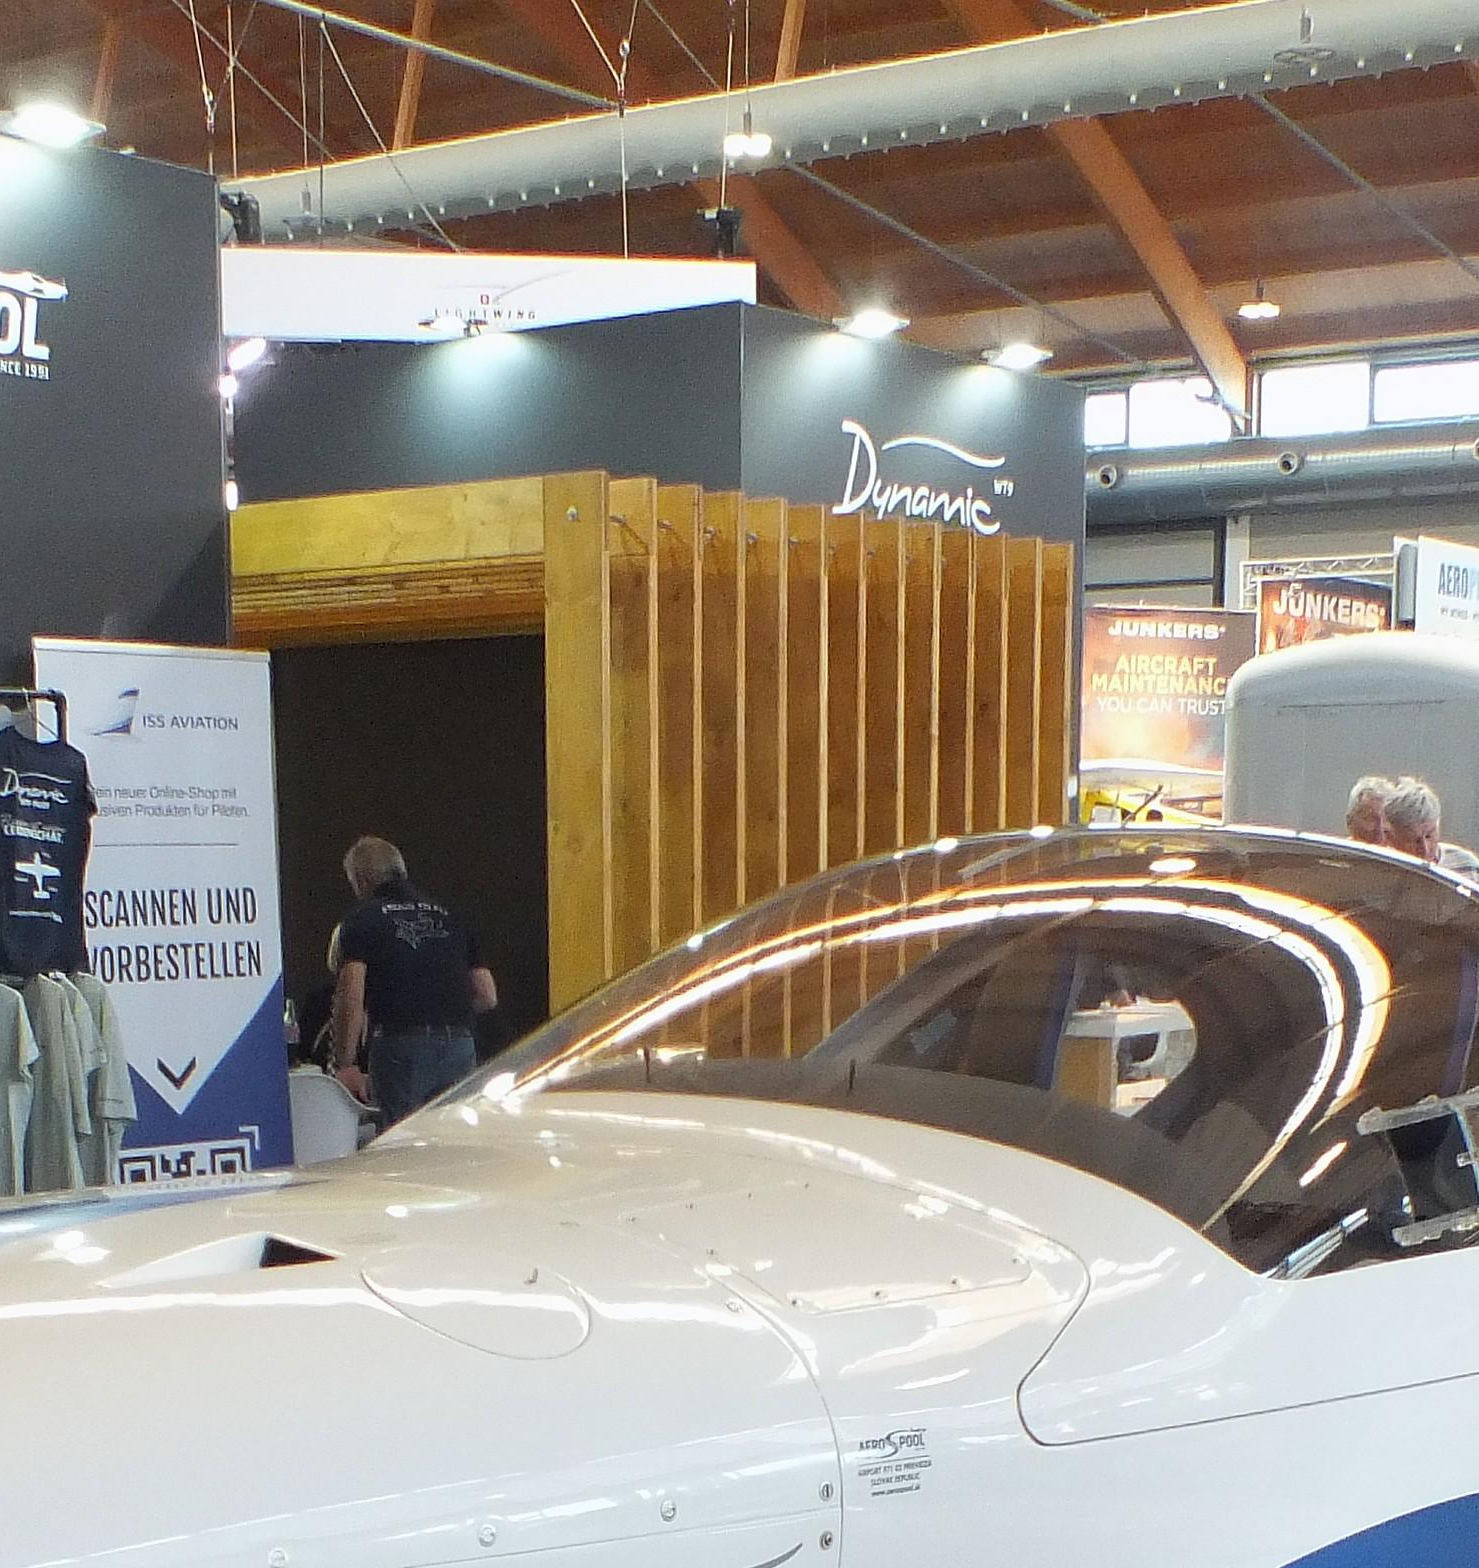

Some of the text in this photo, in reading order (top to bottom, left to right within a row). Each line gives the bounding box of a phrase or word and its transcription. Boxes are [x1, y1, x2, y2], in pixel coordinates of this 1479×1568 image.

[832, 420, 1000, 535] Dynamic
[1273, 588, 1380, 629] JUNKERS
[1108, 620, 1220, 640] JUNKERS
[1114, 655, 1217, 676] AIRCRAFT
[1092, 674, 1229, 696] MAINTENANC
[1097, 697, 1133, 714] YOU
[1136, 698, 1172, 714] CAN
[142, 715, 239, 731] ISS AVIATION
[150, 785, 218, 802] Online-Shop
[220, 786, 236, 800] mit
[135, 804, 190, 817] Produkten
[193, 804, 209, 817] für
[85, 886, 257, 928] SCANNEN UND
[89, 940, 263, 984] VORBESTELLEN
